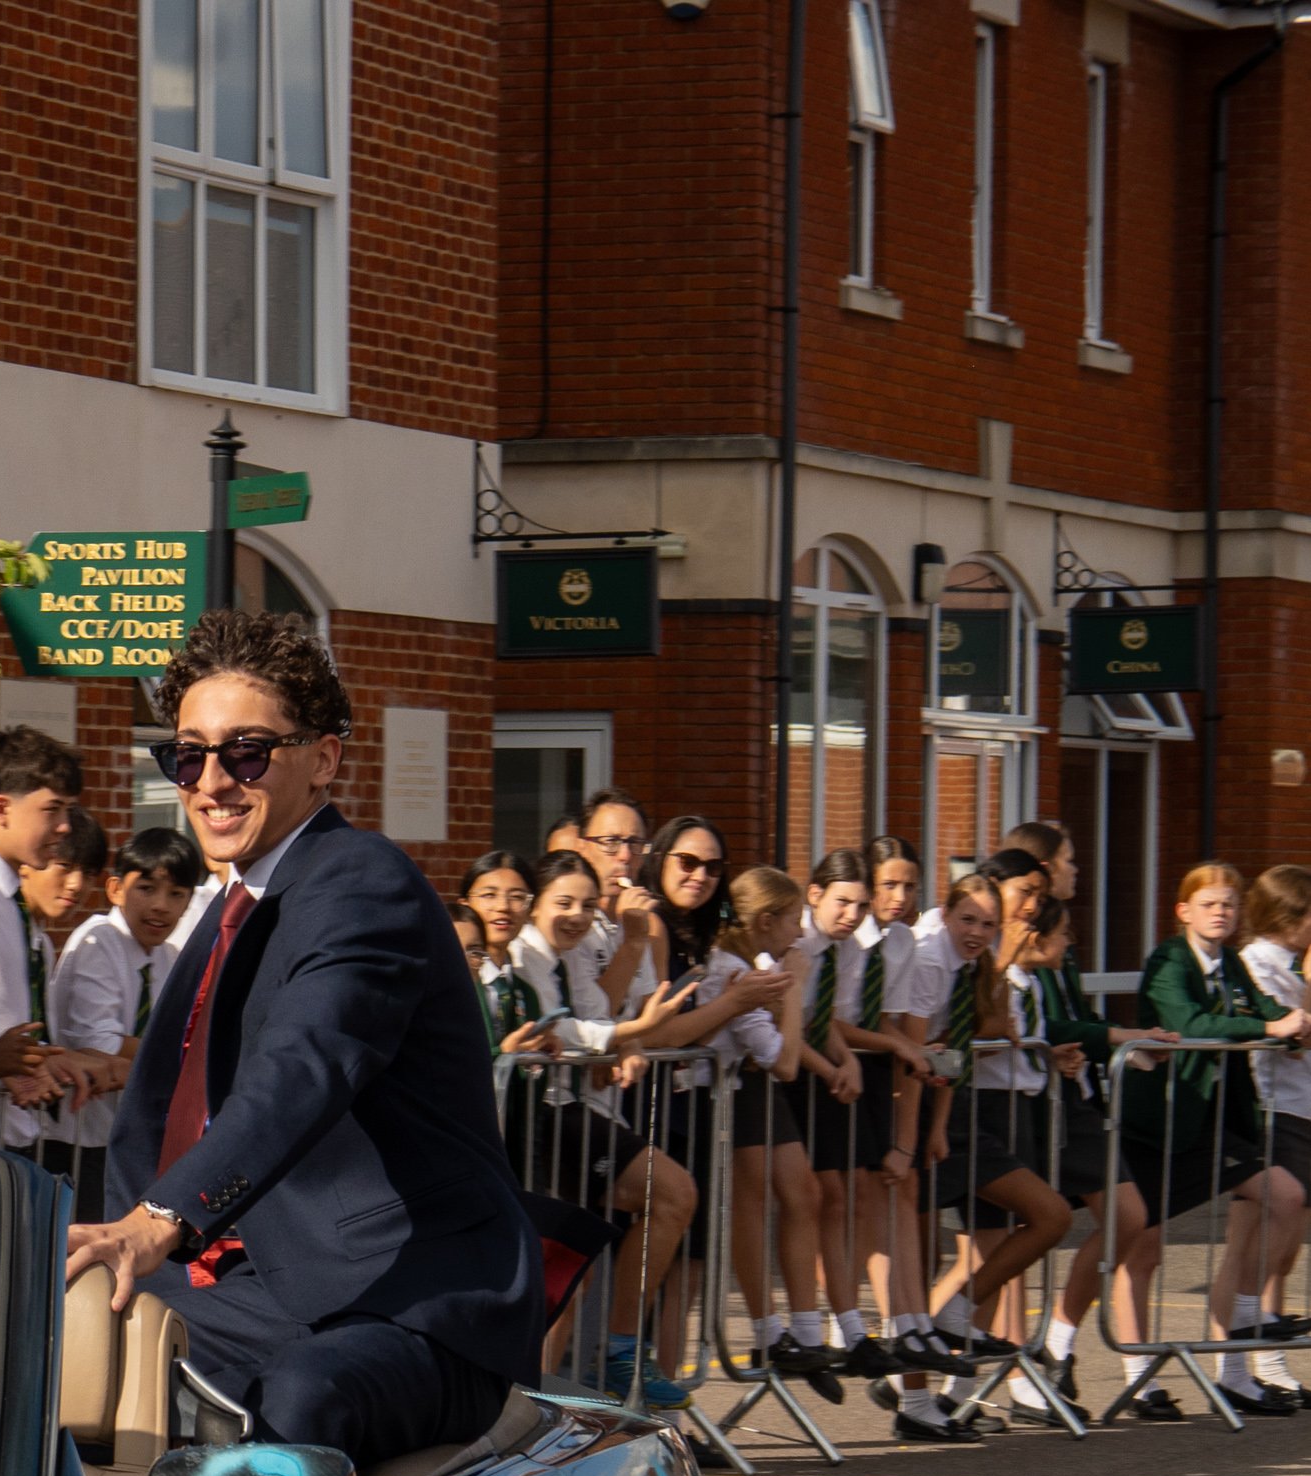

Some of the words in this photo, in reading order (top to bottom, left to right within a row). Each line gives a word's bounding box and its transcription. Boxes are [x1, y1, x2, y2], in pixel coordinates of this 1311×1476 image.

[44, 540, 126, 561] SPORTS
[135, 539, 187, 560] HUB
[80, 566, 186, 586] PAVILION
[39, 592, 101, 612] BACK
[109, 592, 186, 612] FIELDS
[529, 616, 621, 631] VICTORIA
[36, 645, 105, 666] BAND
